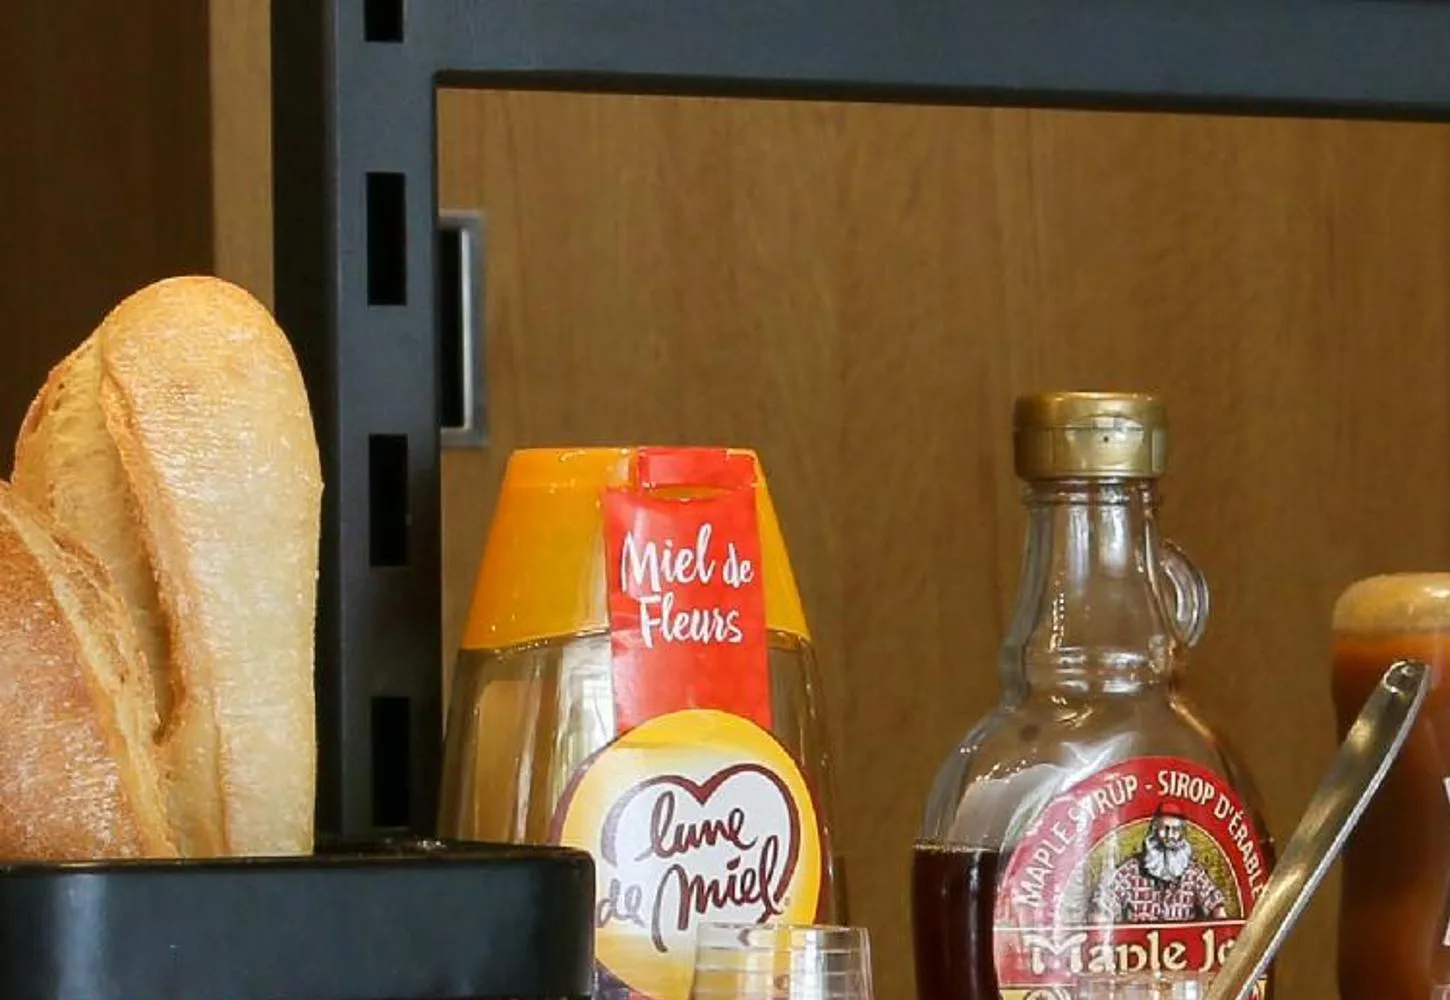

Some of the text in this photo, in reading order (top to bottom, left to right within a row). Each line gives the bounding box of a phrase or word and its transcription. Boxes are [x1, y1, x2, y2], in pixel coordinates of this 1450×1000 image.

[620, 523, 755, 594] Miel de
[639, 592, 743, 648] Fleurs
[1016, 819, 1071, 909] MAPLE
[1067, 773, 1138, 829] SYRUP
[1157, 771, 1216, 806] SIROP
[596, 878, 645, 928] de
[1023, 929, 1238, 975] Maple Jo
